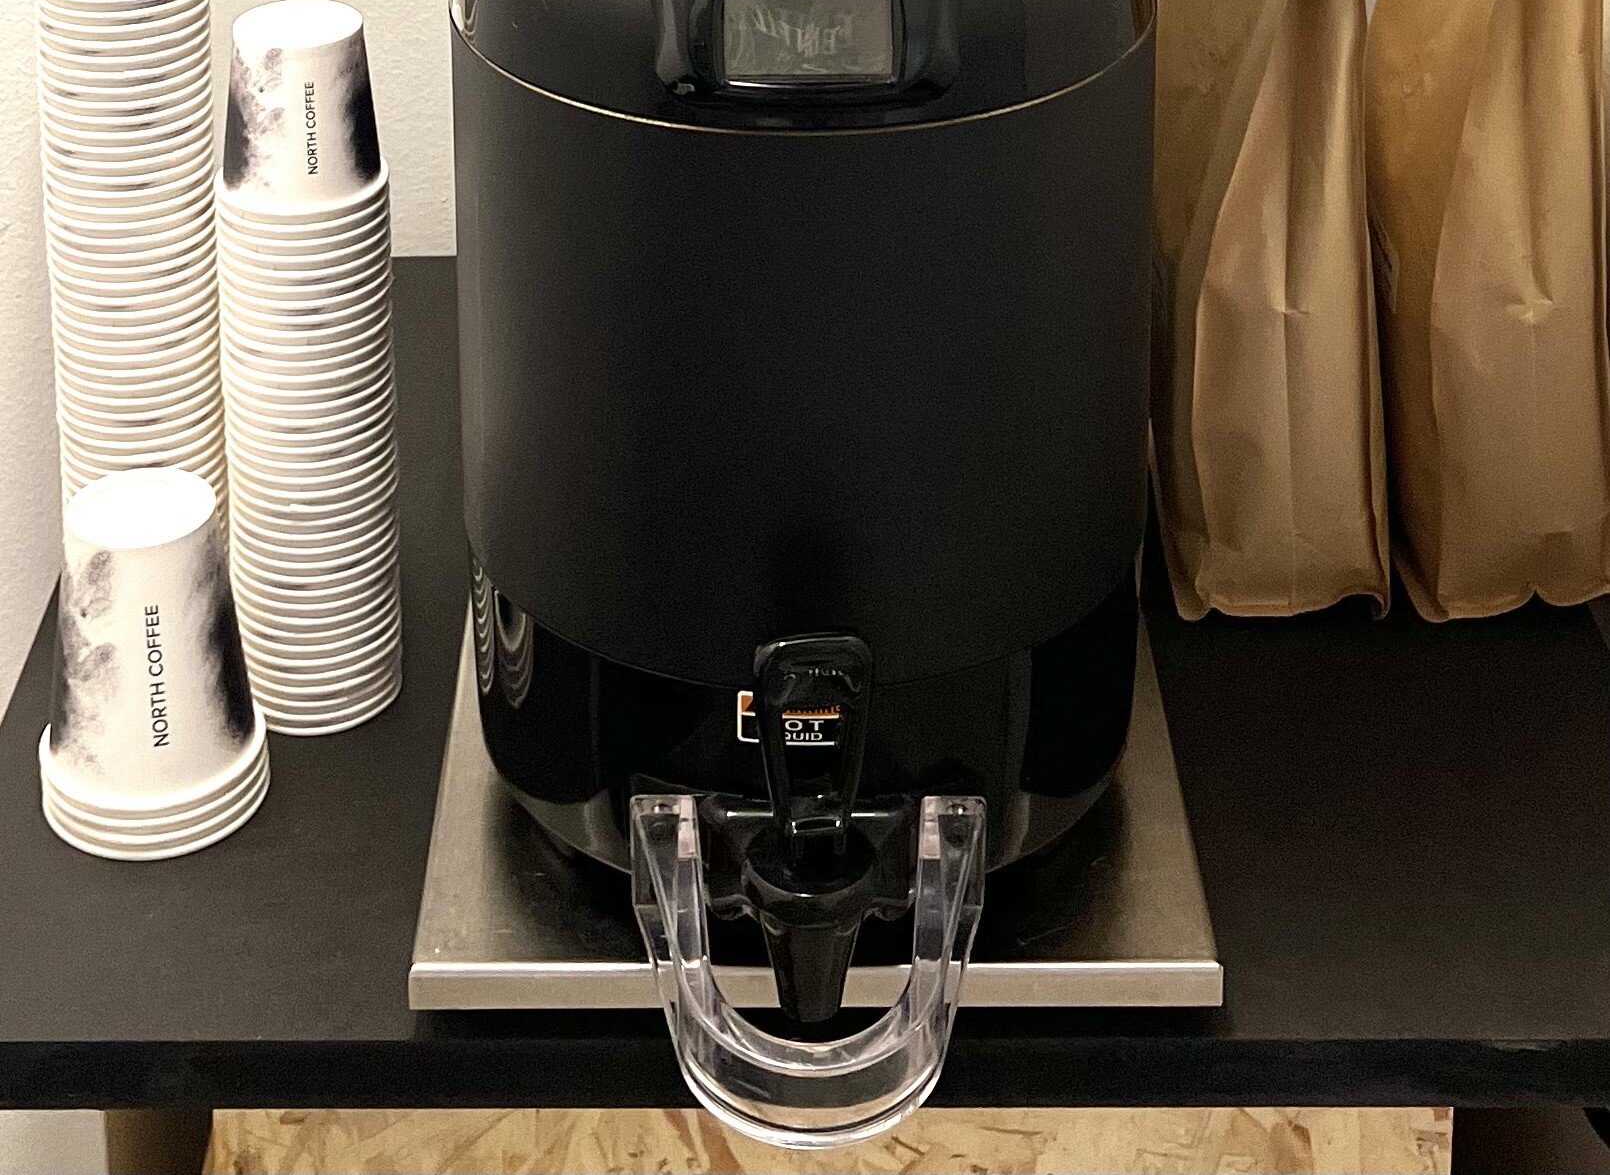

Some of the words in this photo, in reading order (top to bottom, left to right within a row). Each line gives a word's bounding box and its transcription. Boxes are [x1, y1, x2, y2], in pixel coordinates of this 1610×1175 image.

[304, 81, 316, 129] COFFEE
[307, 132, 319, 175] NORTH
[144, 604, 164, 677] COFFEE
[150, 682, 169, 747] NORTH
